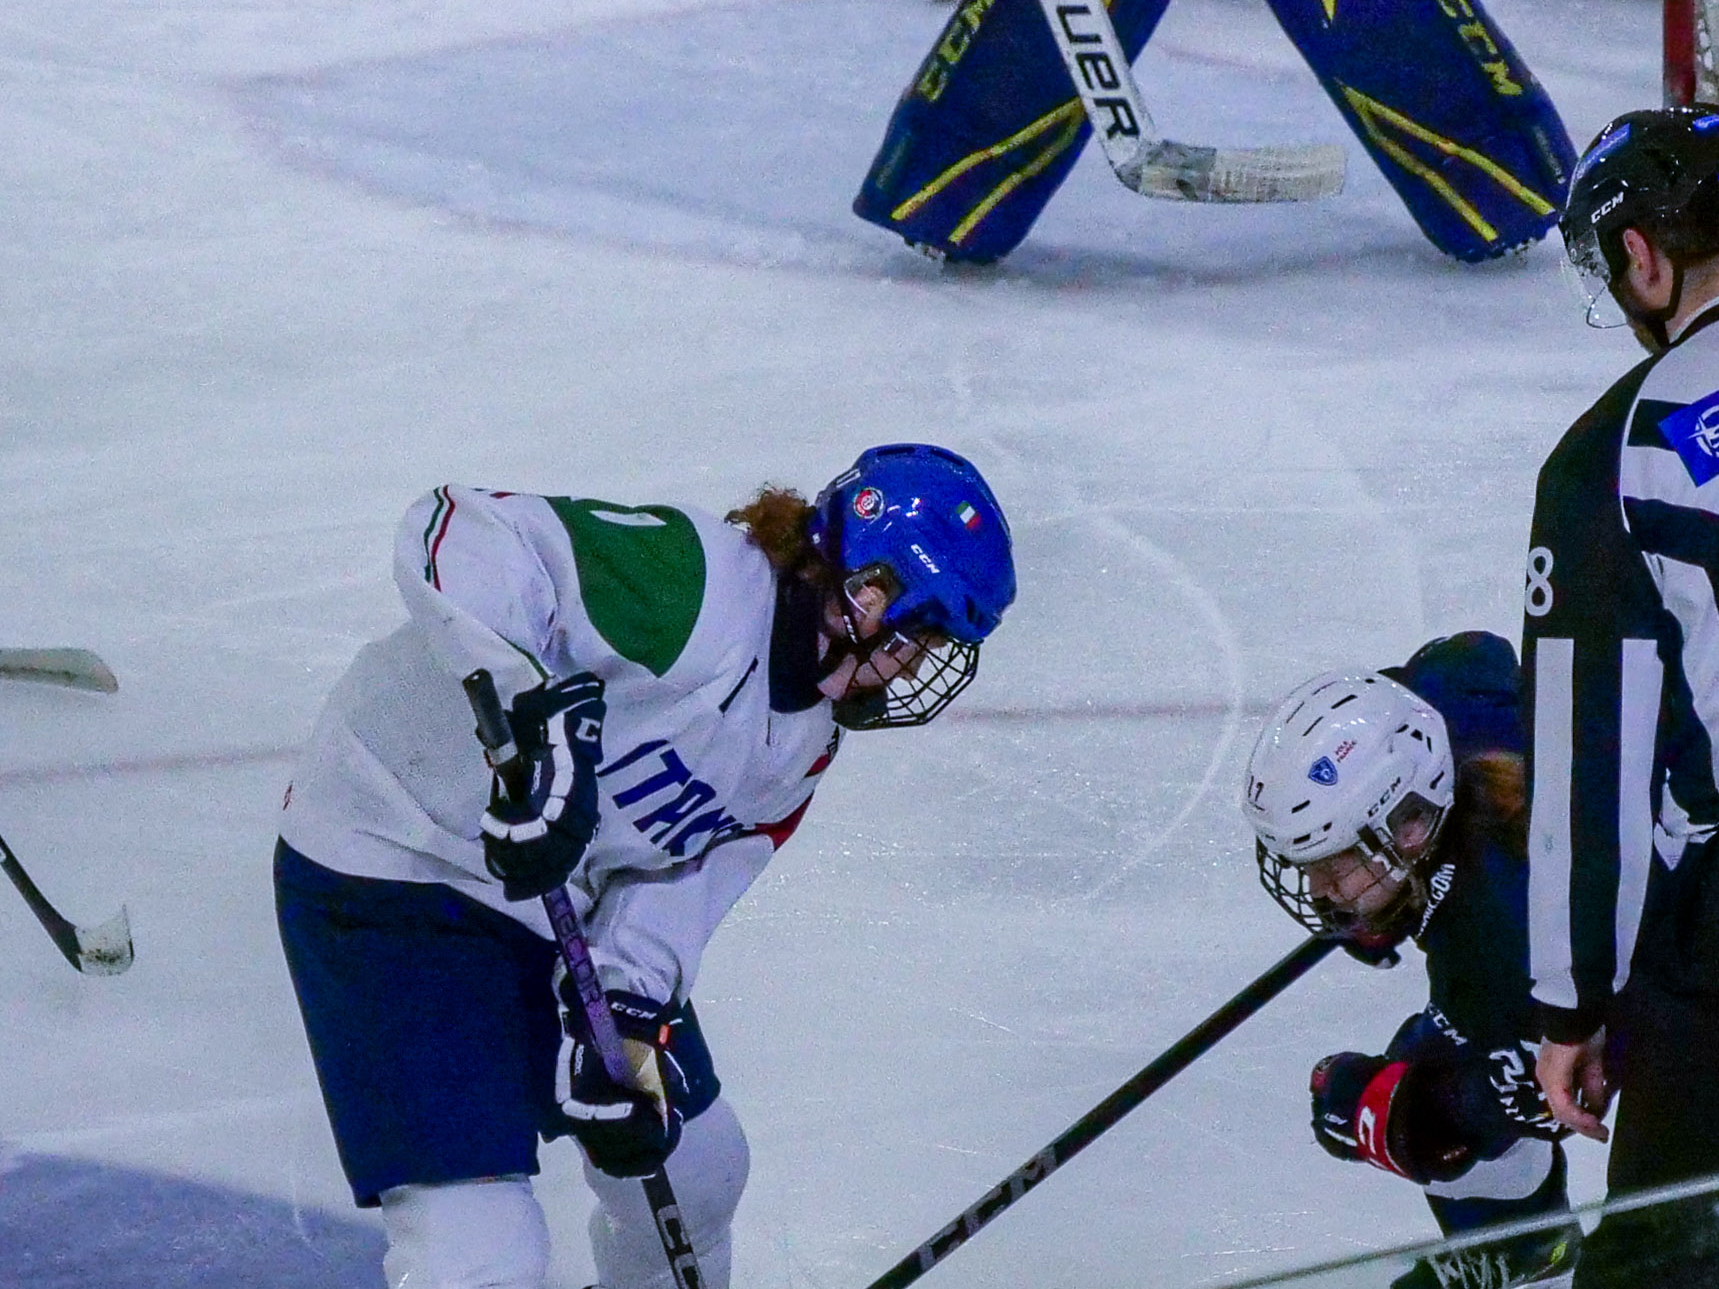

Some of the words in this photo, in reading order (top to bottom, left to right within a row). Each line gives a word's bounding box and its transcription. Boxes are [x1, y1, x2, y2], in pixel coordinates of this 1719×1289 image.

[1591, 191, 1625, 224] CCM
[910, 543, 941, 574] CCM
[1367, 776, 1401, 818] CCM
[610, 1001, 658, 1021] CCM
[921, 1142, 1058, 1272] CCM
